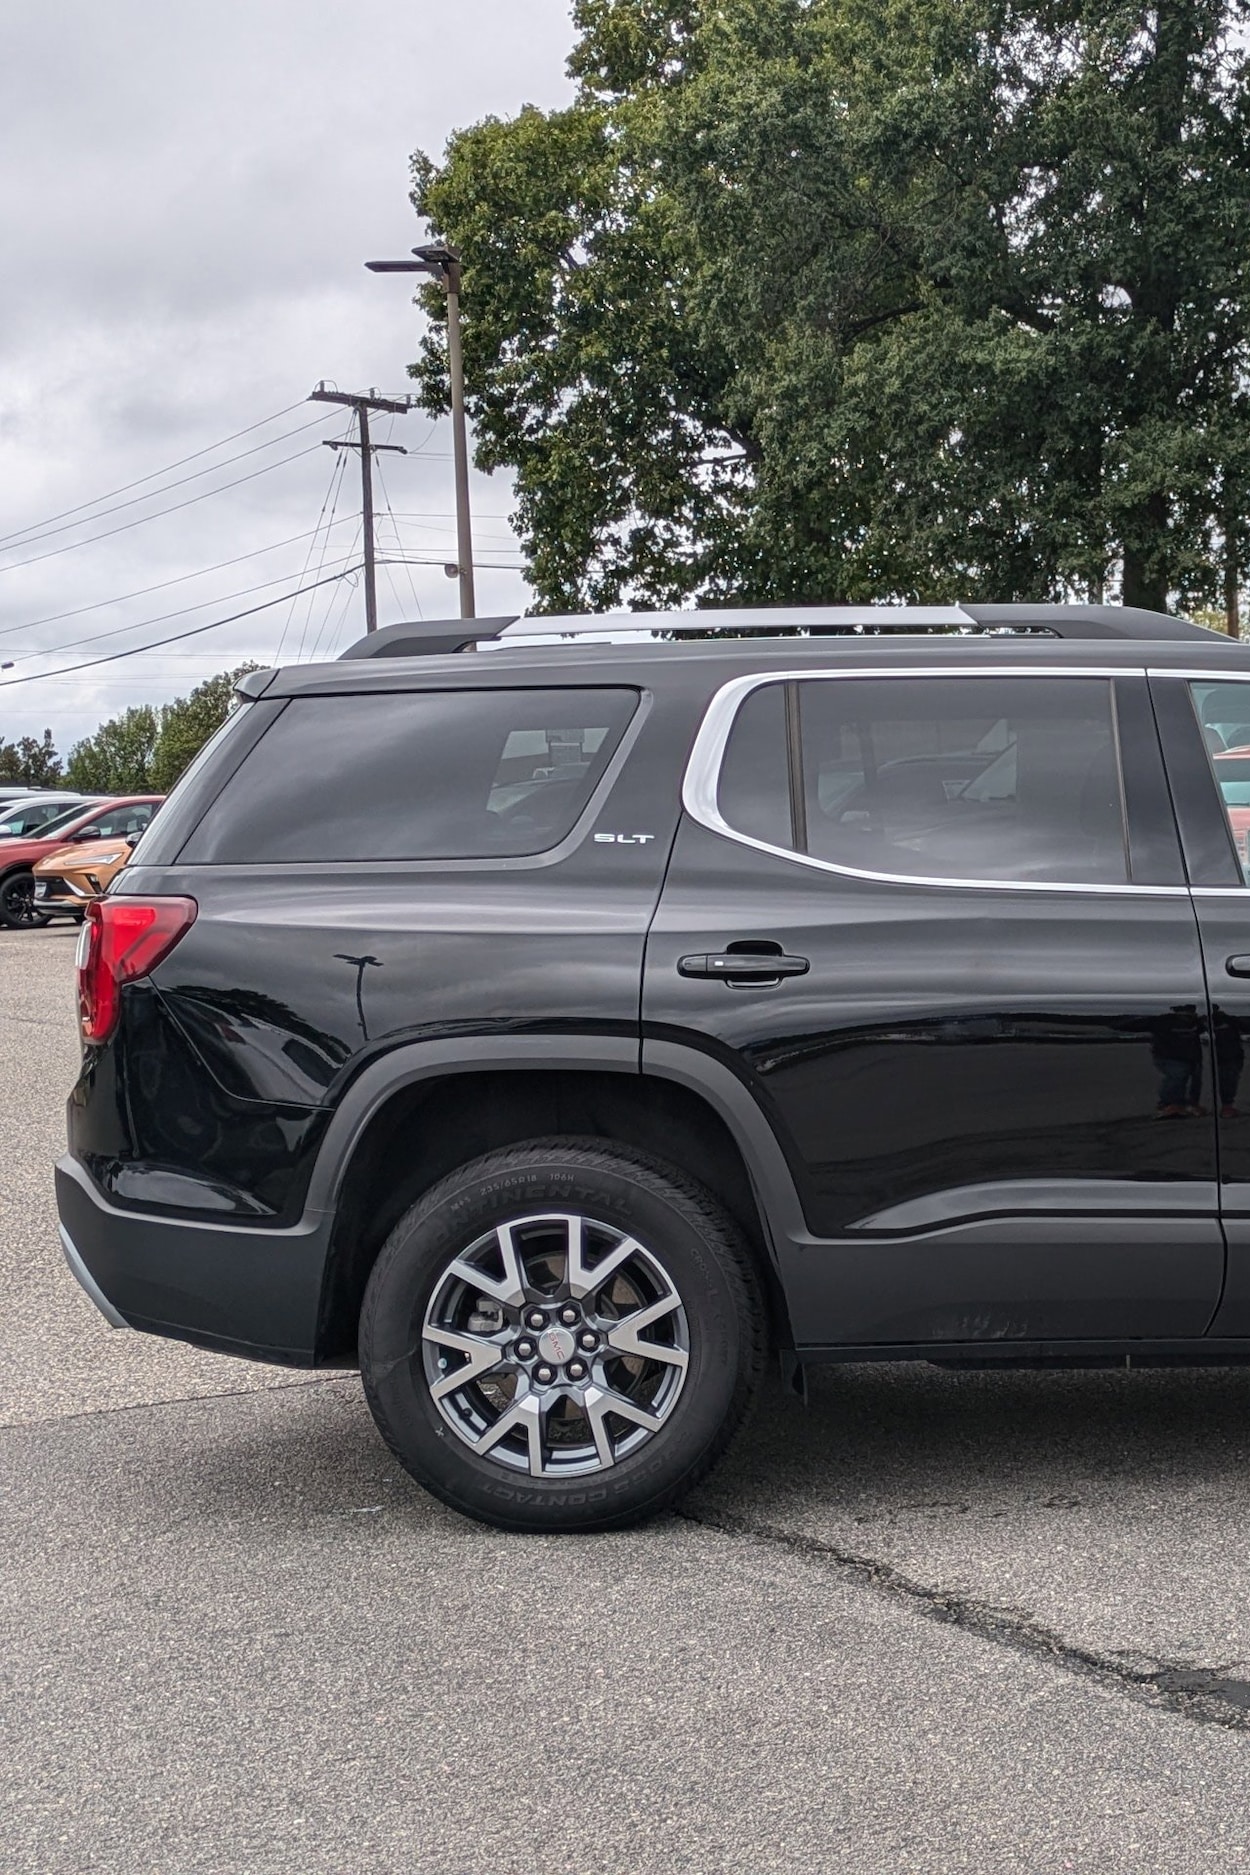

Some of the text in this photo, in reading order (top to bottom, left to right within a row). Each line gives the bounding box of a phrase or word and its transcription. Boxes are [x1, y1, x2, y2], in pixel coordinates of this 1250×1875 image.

[594, 833, 655, 844] SLT
[478, 1173, 537, 1196] 235/65R18
[547, 1331, 565, 1360] GMC
